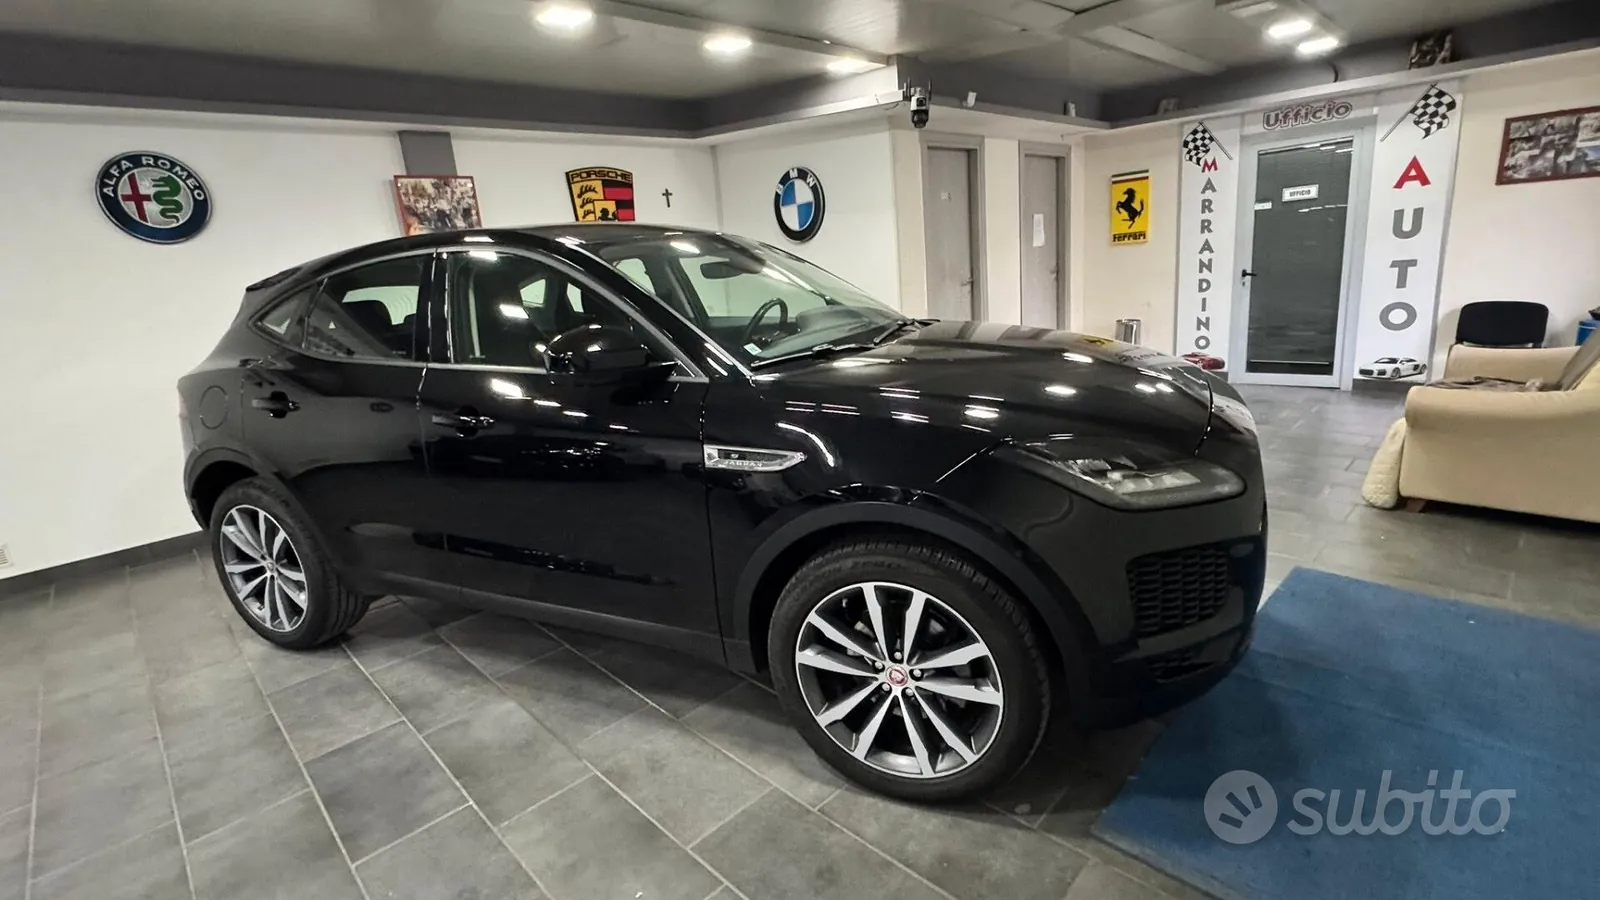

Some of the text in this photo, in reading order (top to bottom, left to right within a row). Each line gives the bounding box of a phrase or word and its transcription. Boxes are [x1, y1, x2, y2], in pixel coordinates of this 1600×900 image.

[1263, 100, 1353, 131] Ufficio
[102, 155, 206, 201] ALFA ROMEO
[570, 169, 633, 182] PORSCHE
[775, 167, 817, 195] BMW
[1289, 188, 1312, 198] UFFICIO
[1112, 231, 1147, 243] Ferrari
[1378, 154, 1432, 332] AUTO
[1193, 156, 1219, 351] MARRANDINO
